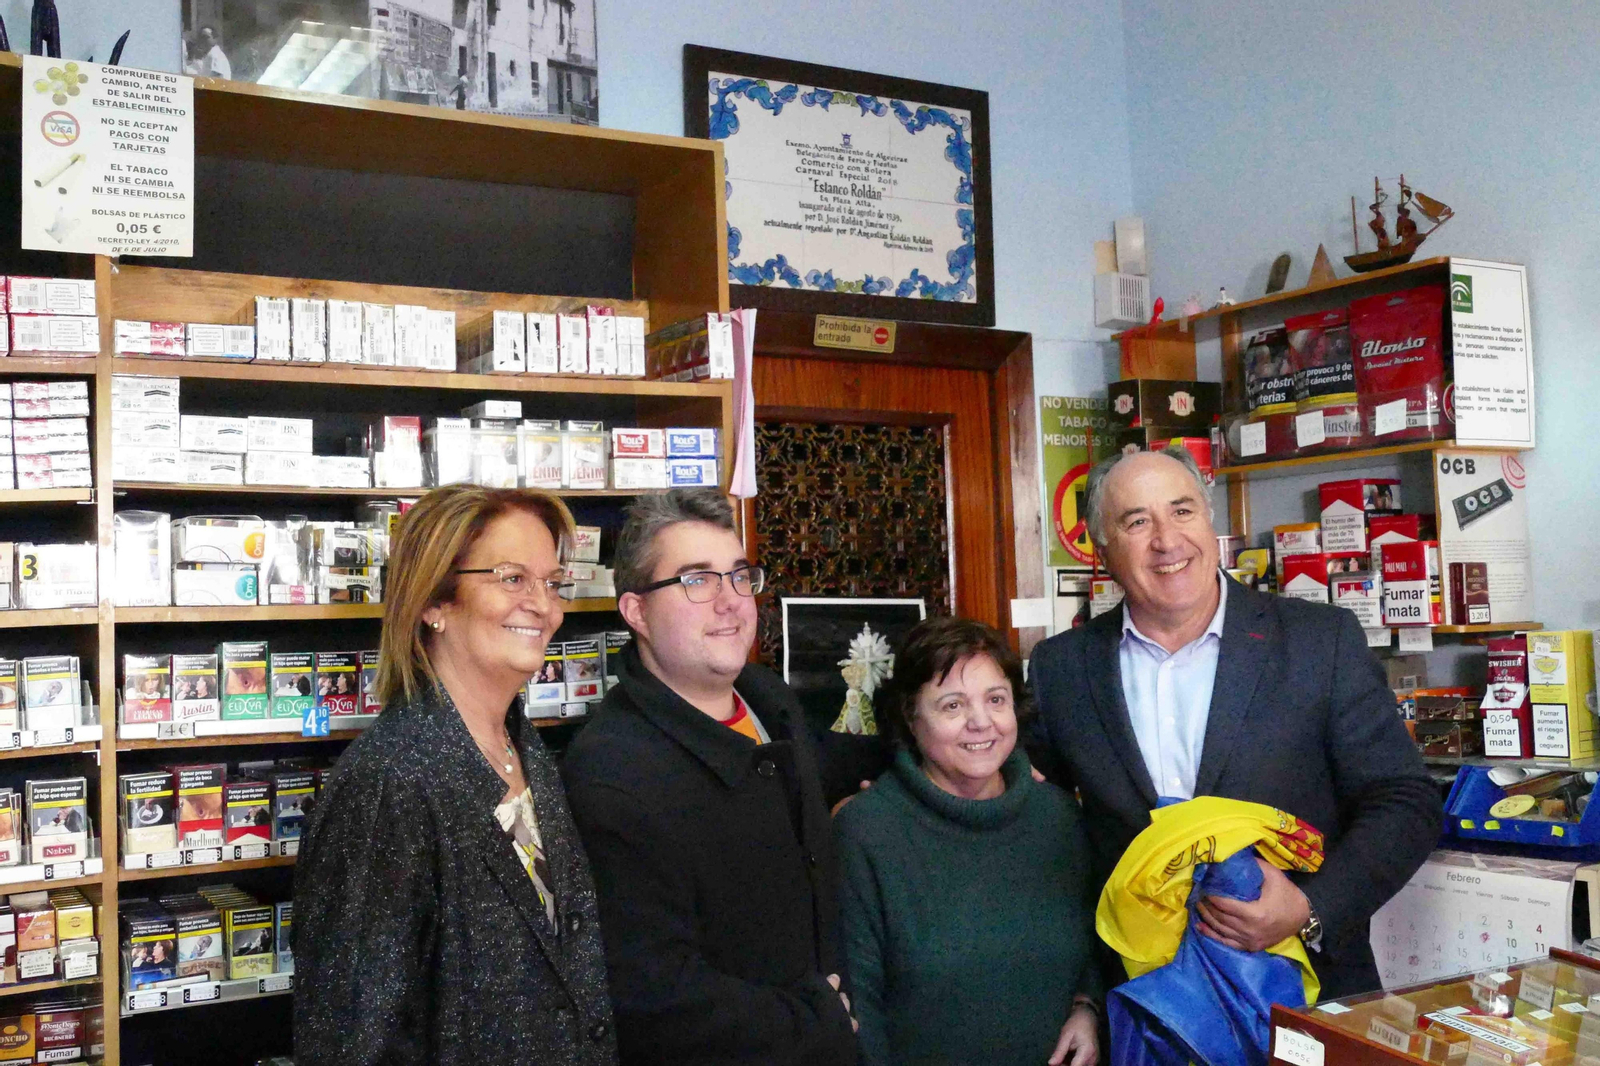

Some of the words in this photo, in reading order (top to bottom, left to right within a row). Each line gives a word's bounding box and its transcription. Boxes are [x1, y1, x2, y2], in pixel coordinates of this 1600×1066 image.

[102, 67, 161, 82] COMPRUEBE
[164, 75, 177, 84] SU
[102, 78, 143, 90] CAMBIO,
[146, 84, 177, 94] ANTES
[122, 91, 151, 101] SALIR
[154, 95, 172, 103] DEL
[92, 99, 186, 116] ESTABLECIMIENTO
[50, 124, 73, 135] VISA
[101, 118, 115, 126] NO
[133, 121, 178, 133] ACEPTAN
[110, 130, 145, 141] PAGOS
[148, 134, 170, 143] CON
[112, 142, 166, 154] TARJETAS
[813, 144, 864, 156] Ayuntamiento
[796, 149, 835, 160] Delegación
[848, 156, 866, 164] Feria
[126, 165, 168, 176] TABACO
[802, 158, 844, 170] Comercio
[864, 167, 892, 176] Solera
[796, 166, 833, 177] Carnaval
[840, 171, 870, 182] Especial
[104, 175, 115, 183] NI
[118, 177, 131, 185] SE
[134, 178, 174, 188] CAMBIA
[92, 186, 103, 194] NI
[106, 187, 120, 195] SE
[123, 188, 186, 200] REEMBOLSA
[92, 209, 126, 217] BOLSAS
[825, 214, 840, 224] José
[116, 223, 148, 235] 0,05
[153, 224, 162, 234] €
[819, 320, 861, 334] Prohibida
[864, 324, 872, 334] la
[818, 333, 852, 343] entrada
[1361, 337, 1427, 358] Alonso
[1306, 367, 1334, 377] provoca
[1342, 362, 1351, 371] de
[1310, 374, 1340, 385] cánceres
[1342, 373, 1352, 381] de
[1044, 397, 1061, 408] NO
[1120, 400, 1128, 409] IN
[1177, 398, 1187, 410] IN
[1059, 416, 1107, 429] TABACO
[1044, 434, 1101, 447] MENORES
[1440, 457, 1476, 475] OCB
[1465, 484, 1503, 512] OCB
[23, 554, 38, 580] 3
[245, 577, 255, 599] Omé
[1384, 588, 1425, 601] Fumar
[1388, 605, 1421, 617] mata
[1471, 612, 1484, 620] 3,20
[1489, 658, 1522, 667] SWISHER
[178, 704, 215, 719] Austin
[1490, 714, 1511, 724] 0,50
[165, 723, 175, 736] 4
[179, 723, 188, 735] €
[321, 721, 327, 734] €
[1486, 727, 1516, 735] Fumar
[1489, 738, 1513, 746] mata
[186, 833, 220, 847] Marlboro
[46, 846, 73, 856] Nobel
[1446, 872, 1482, 885] Febrero
[1500, 894, 1520, 902] Sábado
[1528, 898, 1551, 907] Domingo
[1482, 916, 1488, 926] 2
[1507, 920, 1513, 929] 3
[1536, 925, 1542, 934] 4
[1388, 919, 1394, 927] 5
[1458, 930, 1464, 940] 8
[1482, 933, 1489, 943] 9
[1506, 938, 1517, 948] 10
[1535, 943, 1545, 954] 11
[1458, 948, 1468, 958] 15
[1482, 952, 1492, 963] 16
[1432, 1012, 1480, 1036] Fumar
[1481, 1031, 1522, 1051] mata
[1284, 1034, 1316, 1051] BOLSA
[45, 1050, 74, 1058] Fumar
